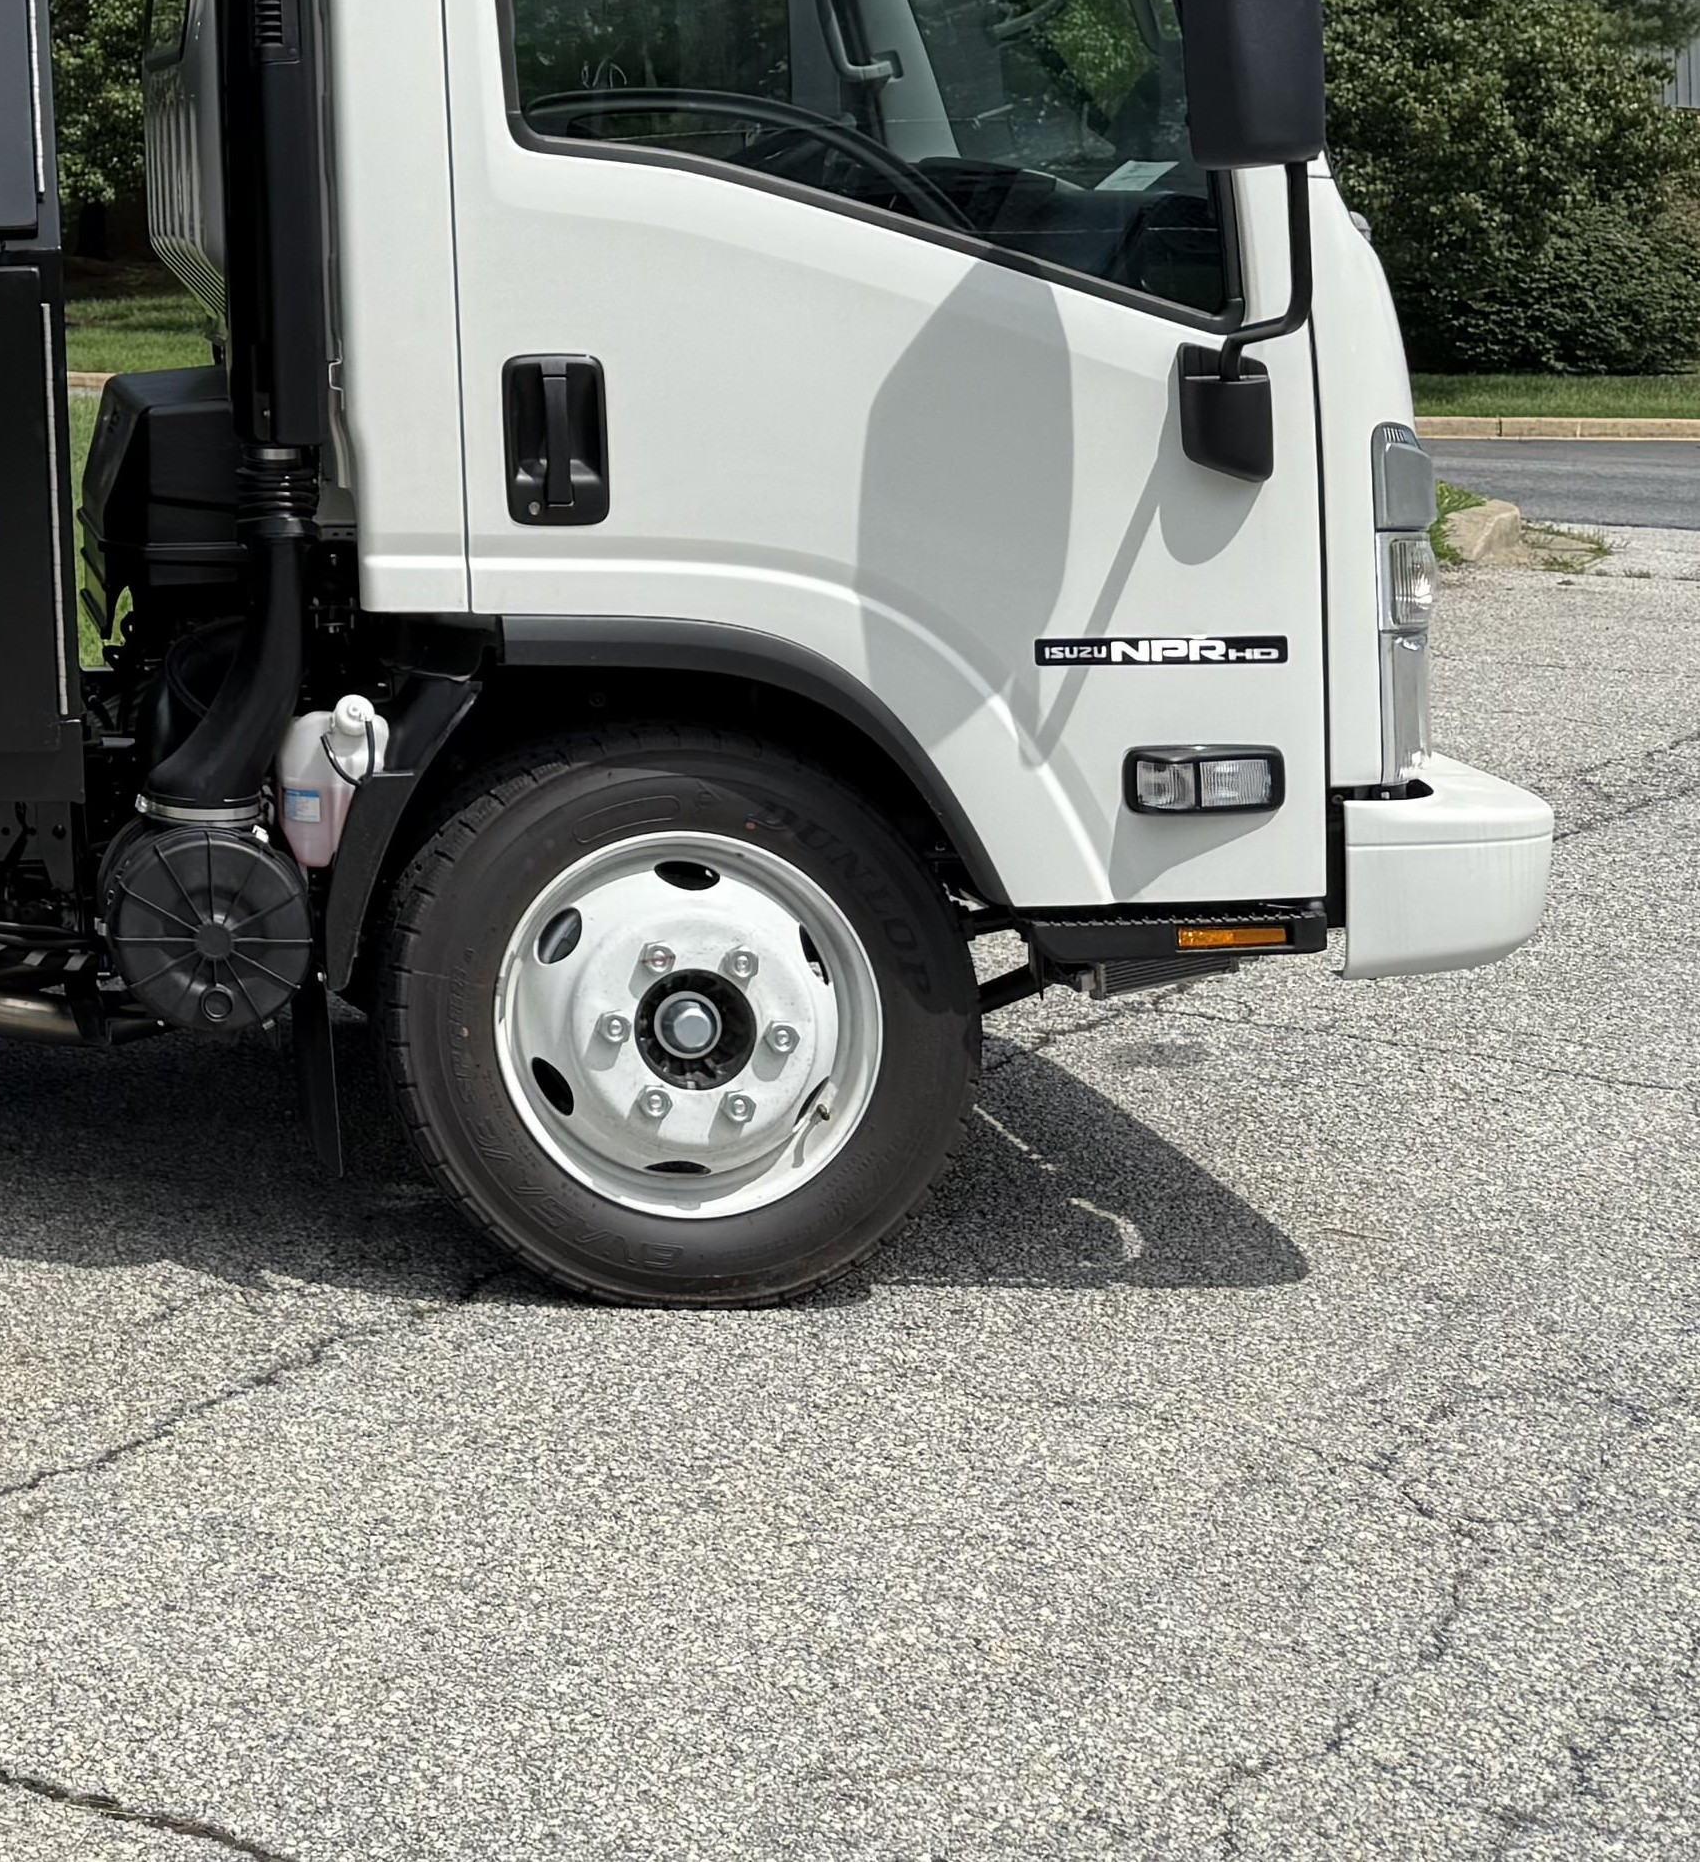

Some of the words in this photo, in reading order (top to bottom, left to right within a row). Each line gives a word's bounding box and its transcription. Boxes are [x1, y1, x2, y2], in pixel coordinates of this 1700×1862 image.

[1045, 646, 1106, 660] ISUZU
[1110, 640, 1227, 663] NPR
[747, 802, 931, 994] DUNLOP
